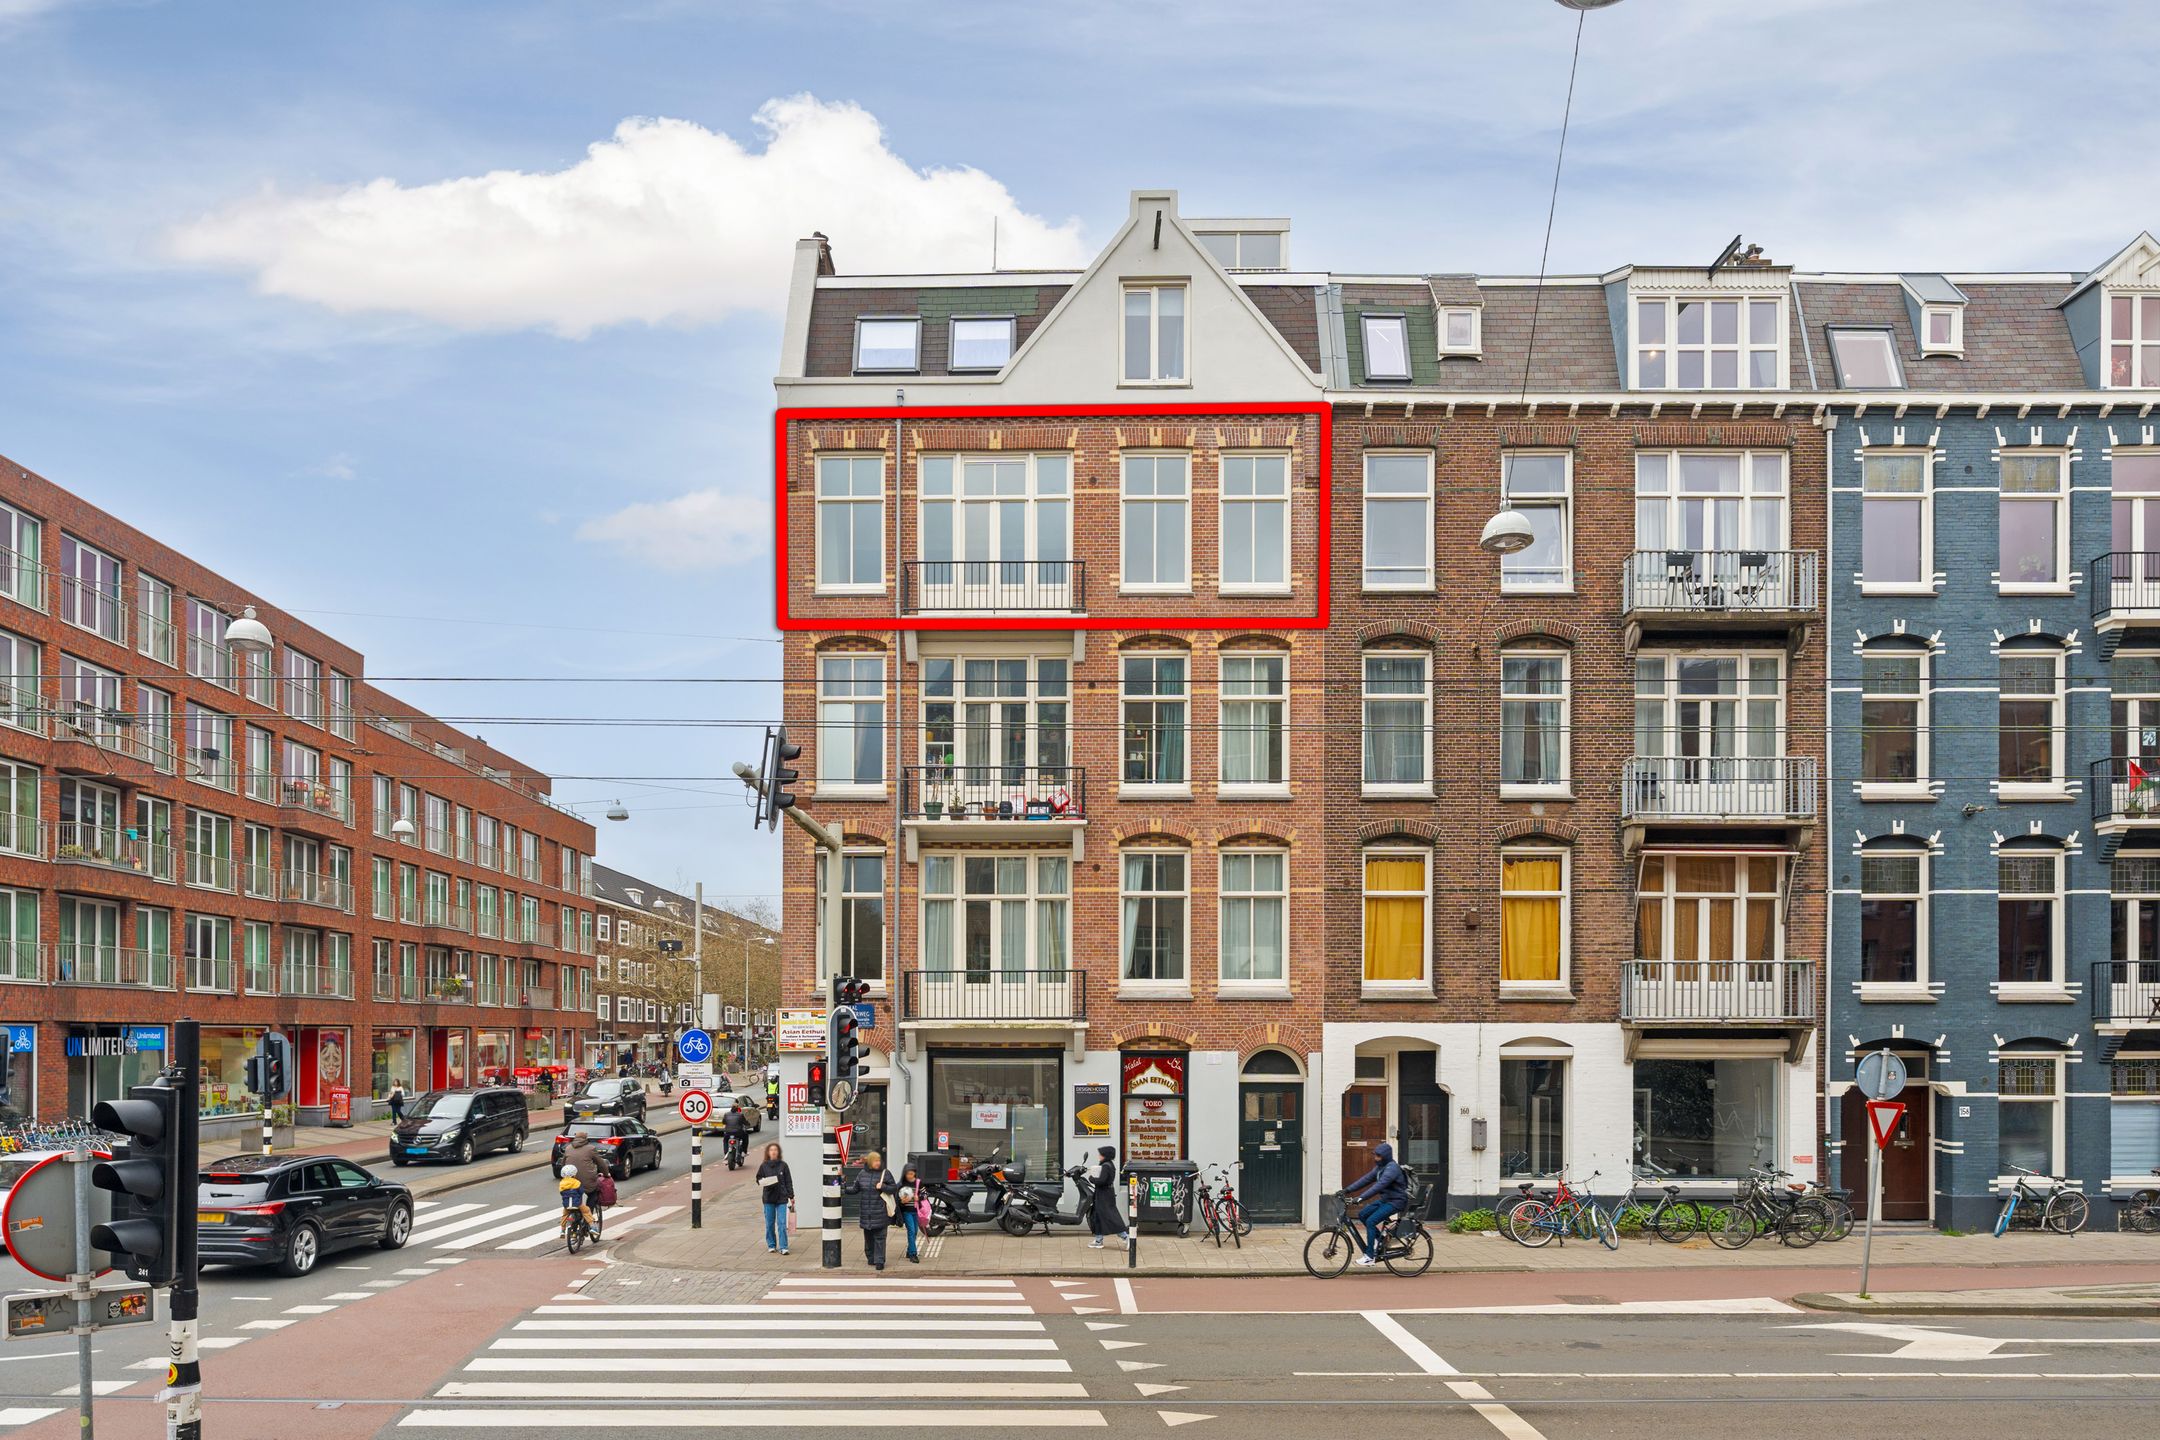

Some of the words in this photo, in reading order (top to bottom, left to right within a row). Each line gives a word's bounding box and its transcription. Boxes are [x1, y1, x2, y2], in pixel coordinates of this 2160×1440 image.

[67, 1037, 124, 1056] UNLIMITED
[1124, 1056, 1142, 1072] Halal
[790, 1087, 808, 1102] KO
[686, 1100, 706, 1113] 30
[1460, 1107, 1469, 1115] 160
[795, 1115, 820, 1123] DAPPER
[138, 1267, 149, 1277] 241
